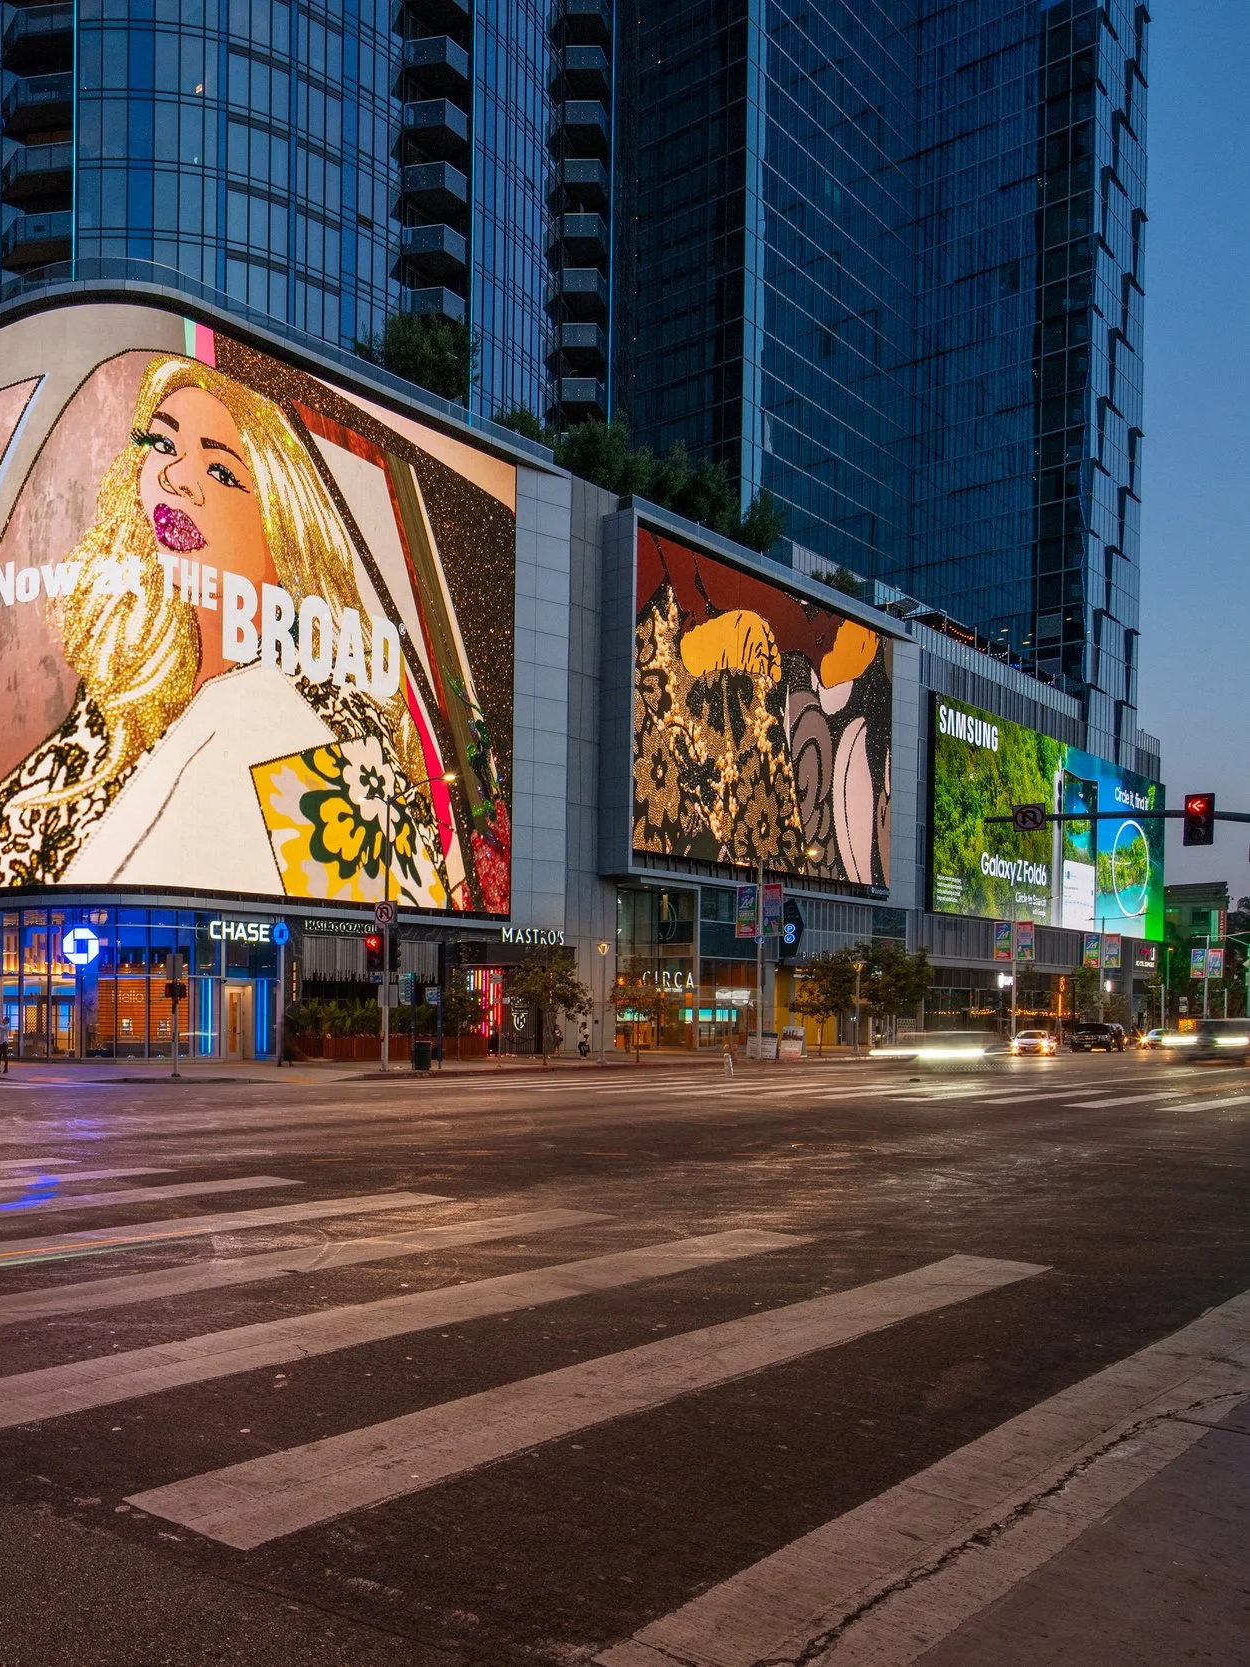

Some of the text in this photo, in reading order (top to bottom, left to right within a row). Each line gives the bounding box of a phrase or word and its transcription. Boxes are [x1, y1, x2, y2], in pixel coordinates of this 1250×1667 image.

[157, 552, 218, 611] THE
[222, 570, 402, 697] BROAD
[939, 704, 999, 752] SAMSUNG
[981, 851, 1047, 887] Galaxy Z Fold6
[209, 920, 271, 943] CHASE
[502, 927, 565, 946] MASTRO'S
[642, 970, 694, 988] CIRCA
[111, 990, 144, 1003] Hello
